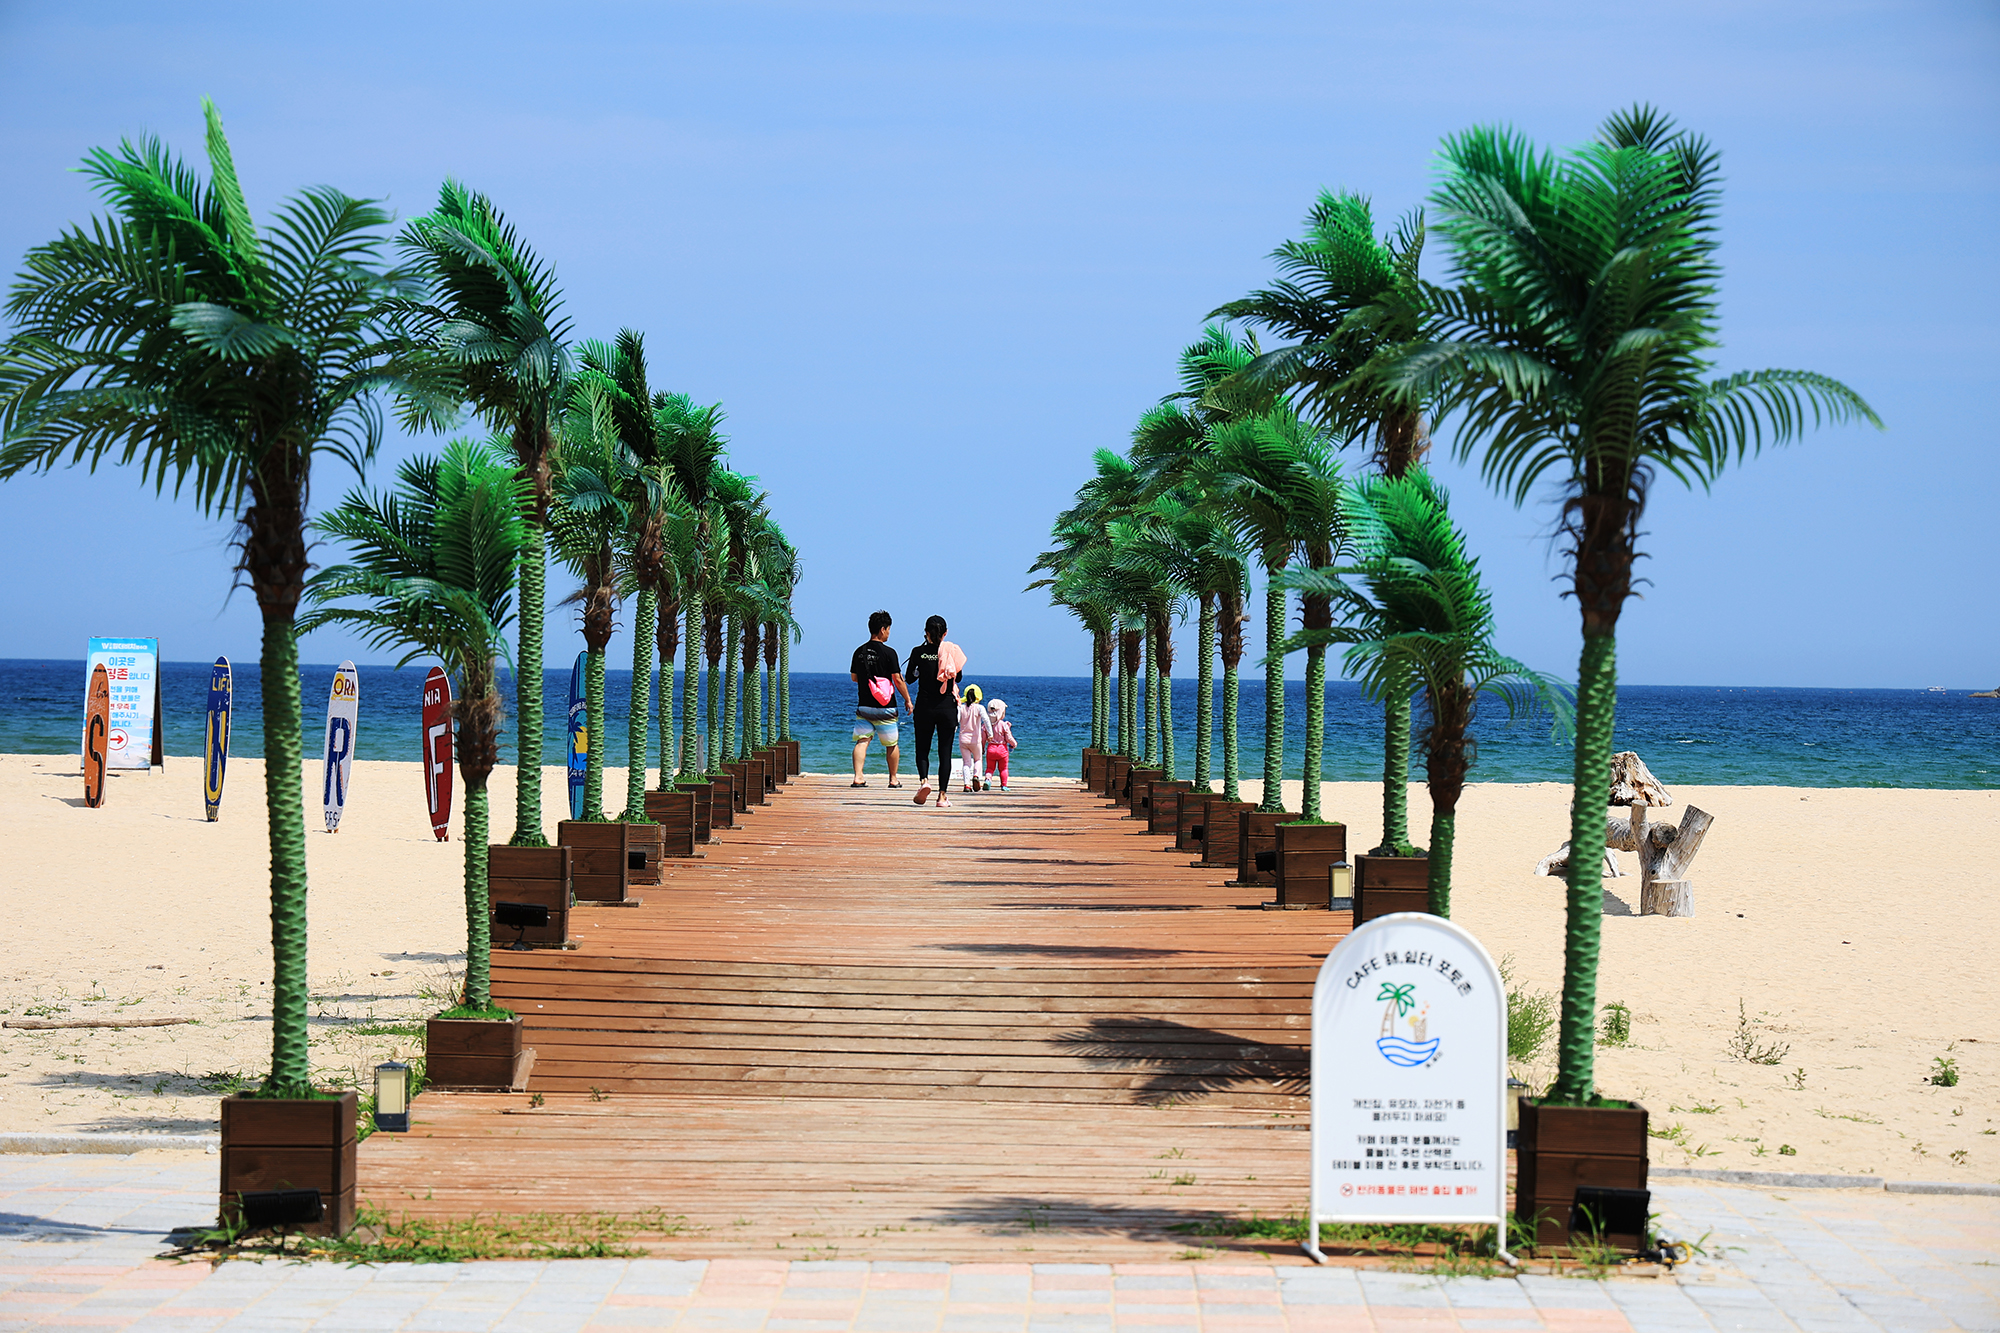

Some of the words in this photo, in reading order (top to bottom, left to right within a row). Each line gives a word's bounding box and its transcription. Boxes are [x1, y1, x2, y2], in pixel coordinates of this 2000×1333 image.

[107, 668, 150, 680] 핑존입니다
[109, 656, 136, 666] 이곳은
[89, 713, 105, 808] S
[206, 710, 228, 803] U
[323, 716, 352, 807] R
[428, 722, 448, 815] F
[1346, 957, 1381, 989] CAFE
[1435, 960, 1472, 997] 포토존
